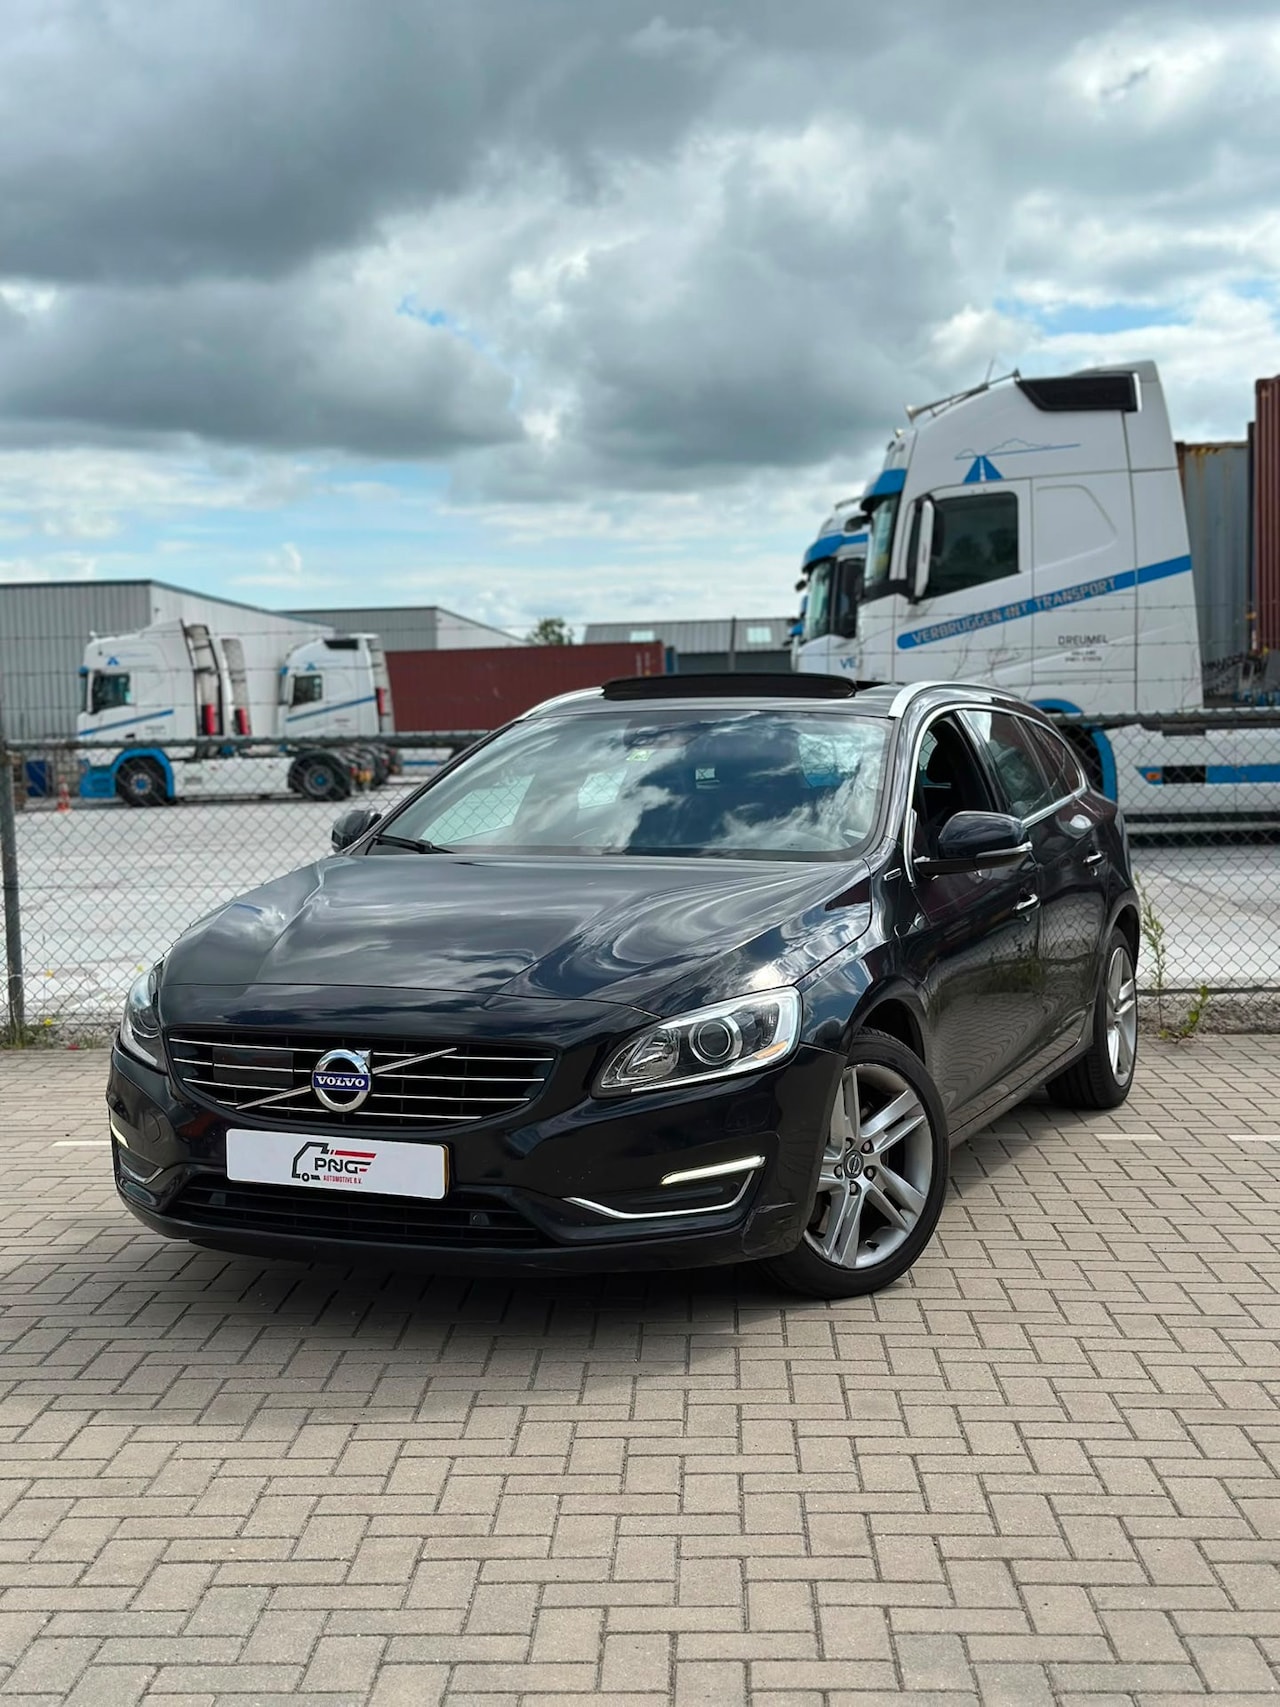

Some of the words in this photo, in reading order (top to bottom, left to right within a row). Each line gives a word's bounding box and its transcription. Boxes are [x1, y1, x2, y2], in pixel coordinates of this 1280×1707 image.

[911, 608, 1003, 645] VERBRUGGEN
[1033, 577, 1116, 613] TRANSPORT
[1057, 634, 1109, 646] DREUMEL
[315, 1075, 366, 1088] VOLVO
[314, 1156, 372, 1175] PNG
[323, 1174, 353, 1184] AUTOMOTIVE
